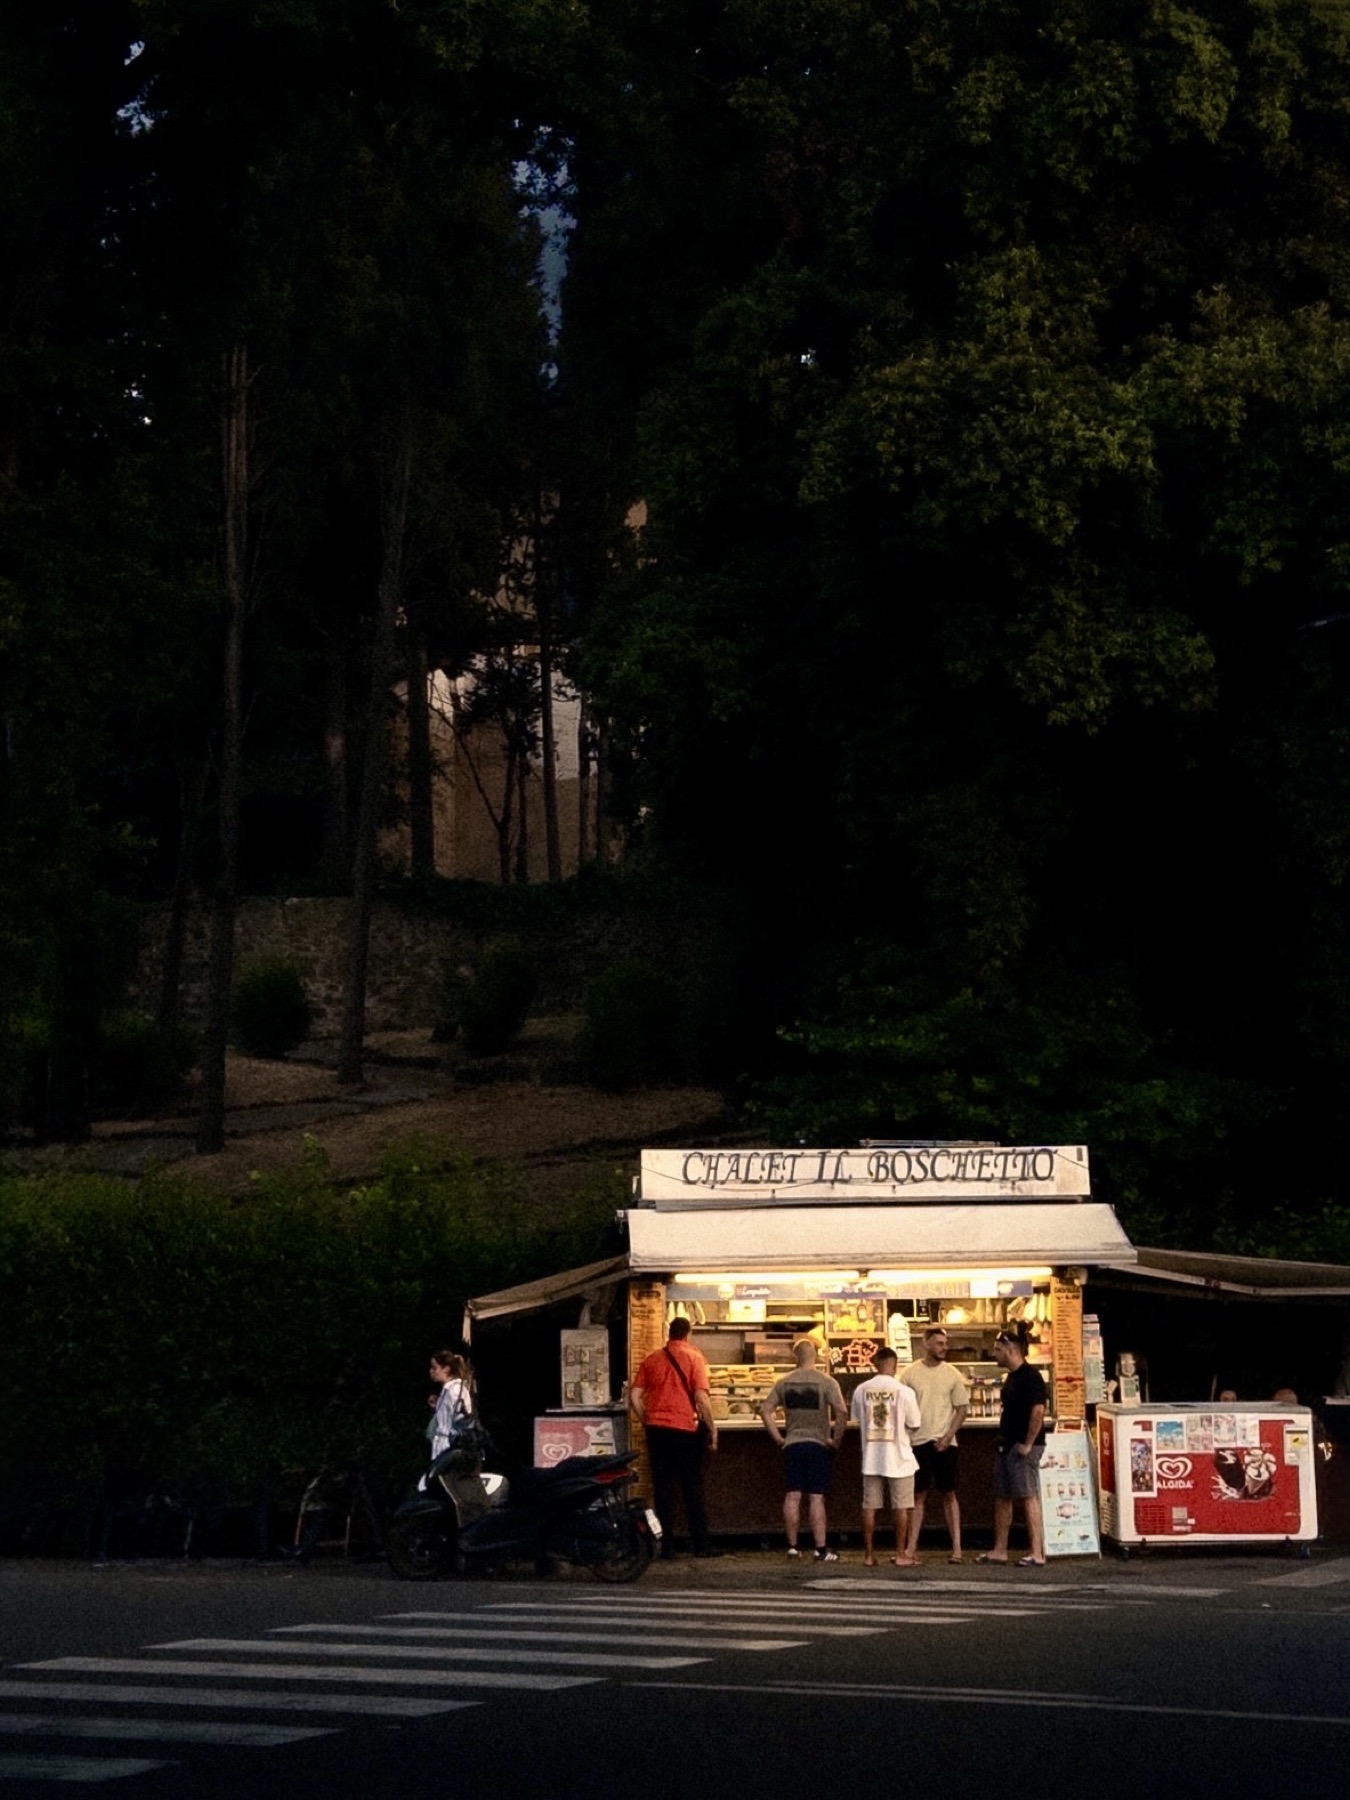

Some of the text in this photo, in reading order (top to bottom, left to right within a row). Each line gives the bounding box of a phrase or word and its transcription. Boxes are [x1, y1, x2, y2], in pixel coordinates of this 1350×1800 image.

[681, 1147, 1055, 1186] CHALET IL BOSCHETTO
[865, 1391, 895, 1402] RVCA
[1156, 1479, 1193, 1489] ALGIDA
